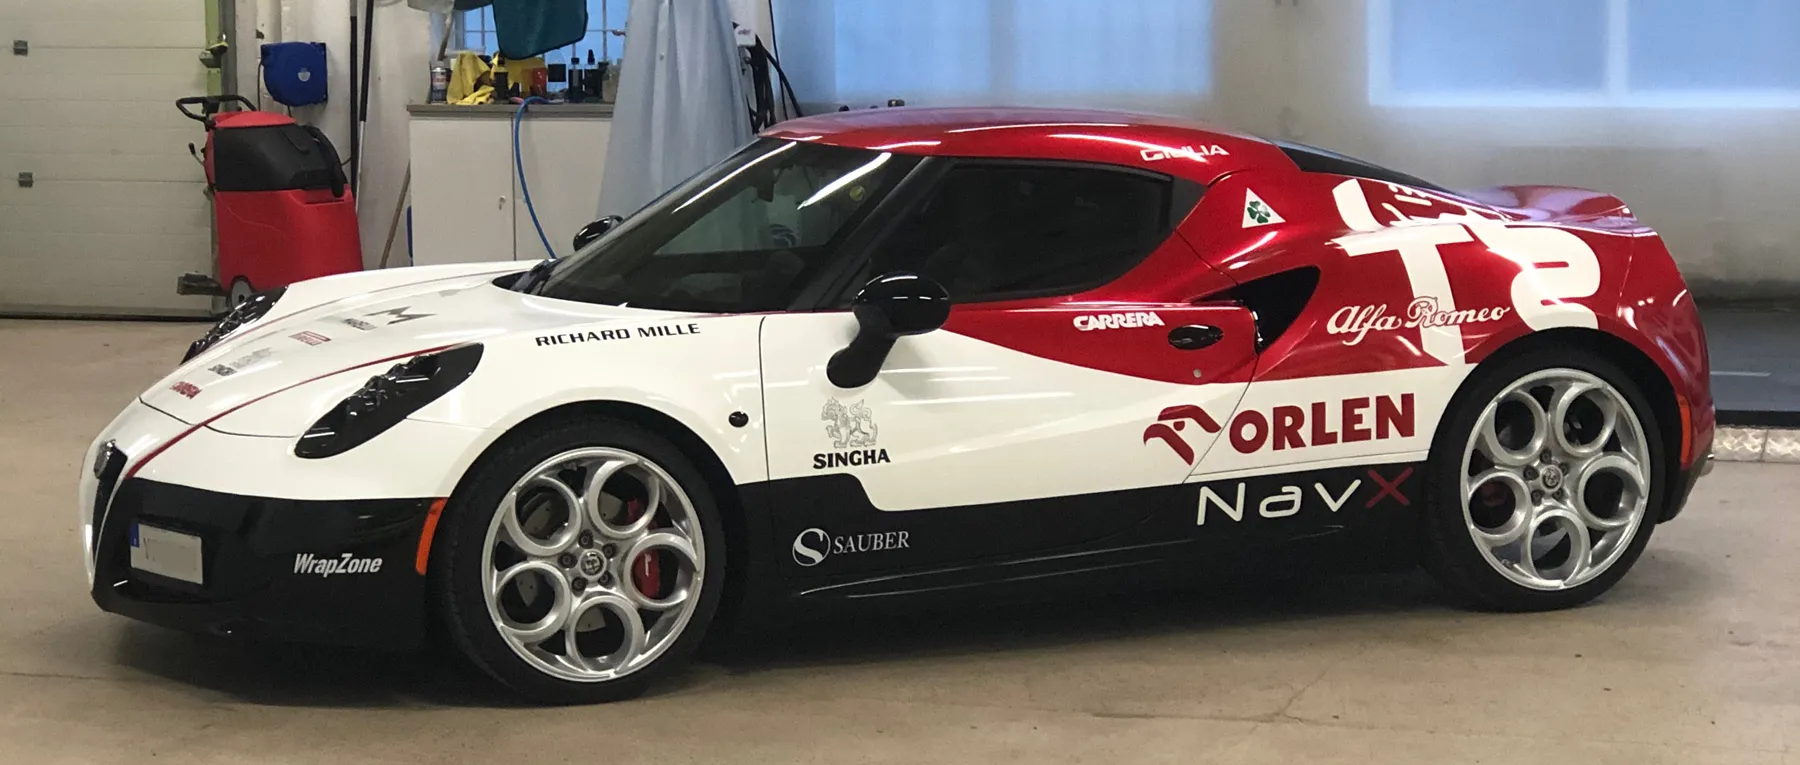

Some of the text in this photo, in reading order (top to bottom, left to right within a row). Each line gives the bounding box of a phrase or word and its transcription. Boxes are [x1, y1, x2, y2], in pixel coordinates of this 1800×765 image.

[1073, 311, 1165, 331] CARRERA
[1326, 296, 1510, 346] Alfa Romeo
[535, 323, 701, 347] RICHARD MILLE
[1229, 393, 1415, 454] ORLEN
[813, 448, 891, 469] SINGHA
[833, 531, 910, 554] SAUBER
[293, 553, 383, 578] WrapZone
